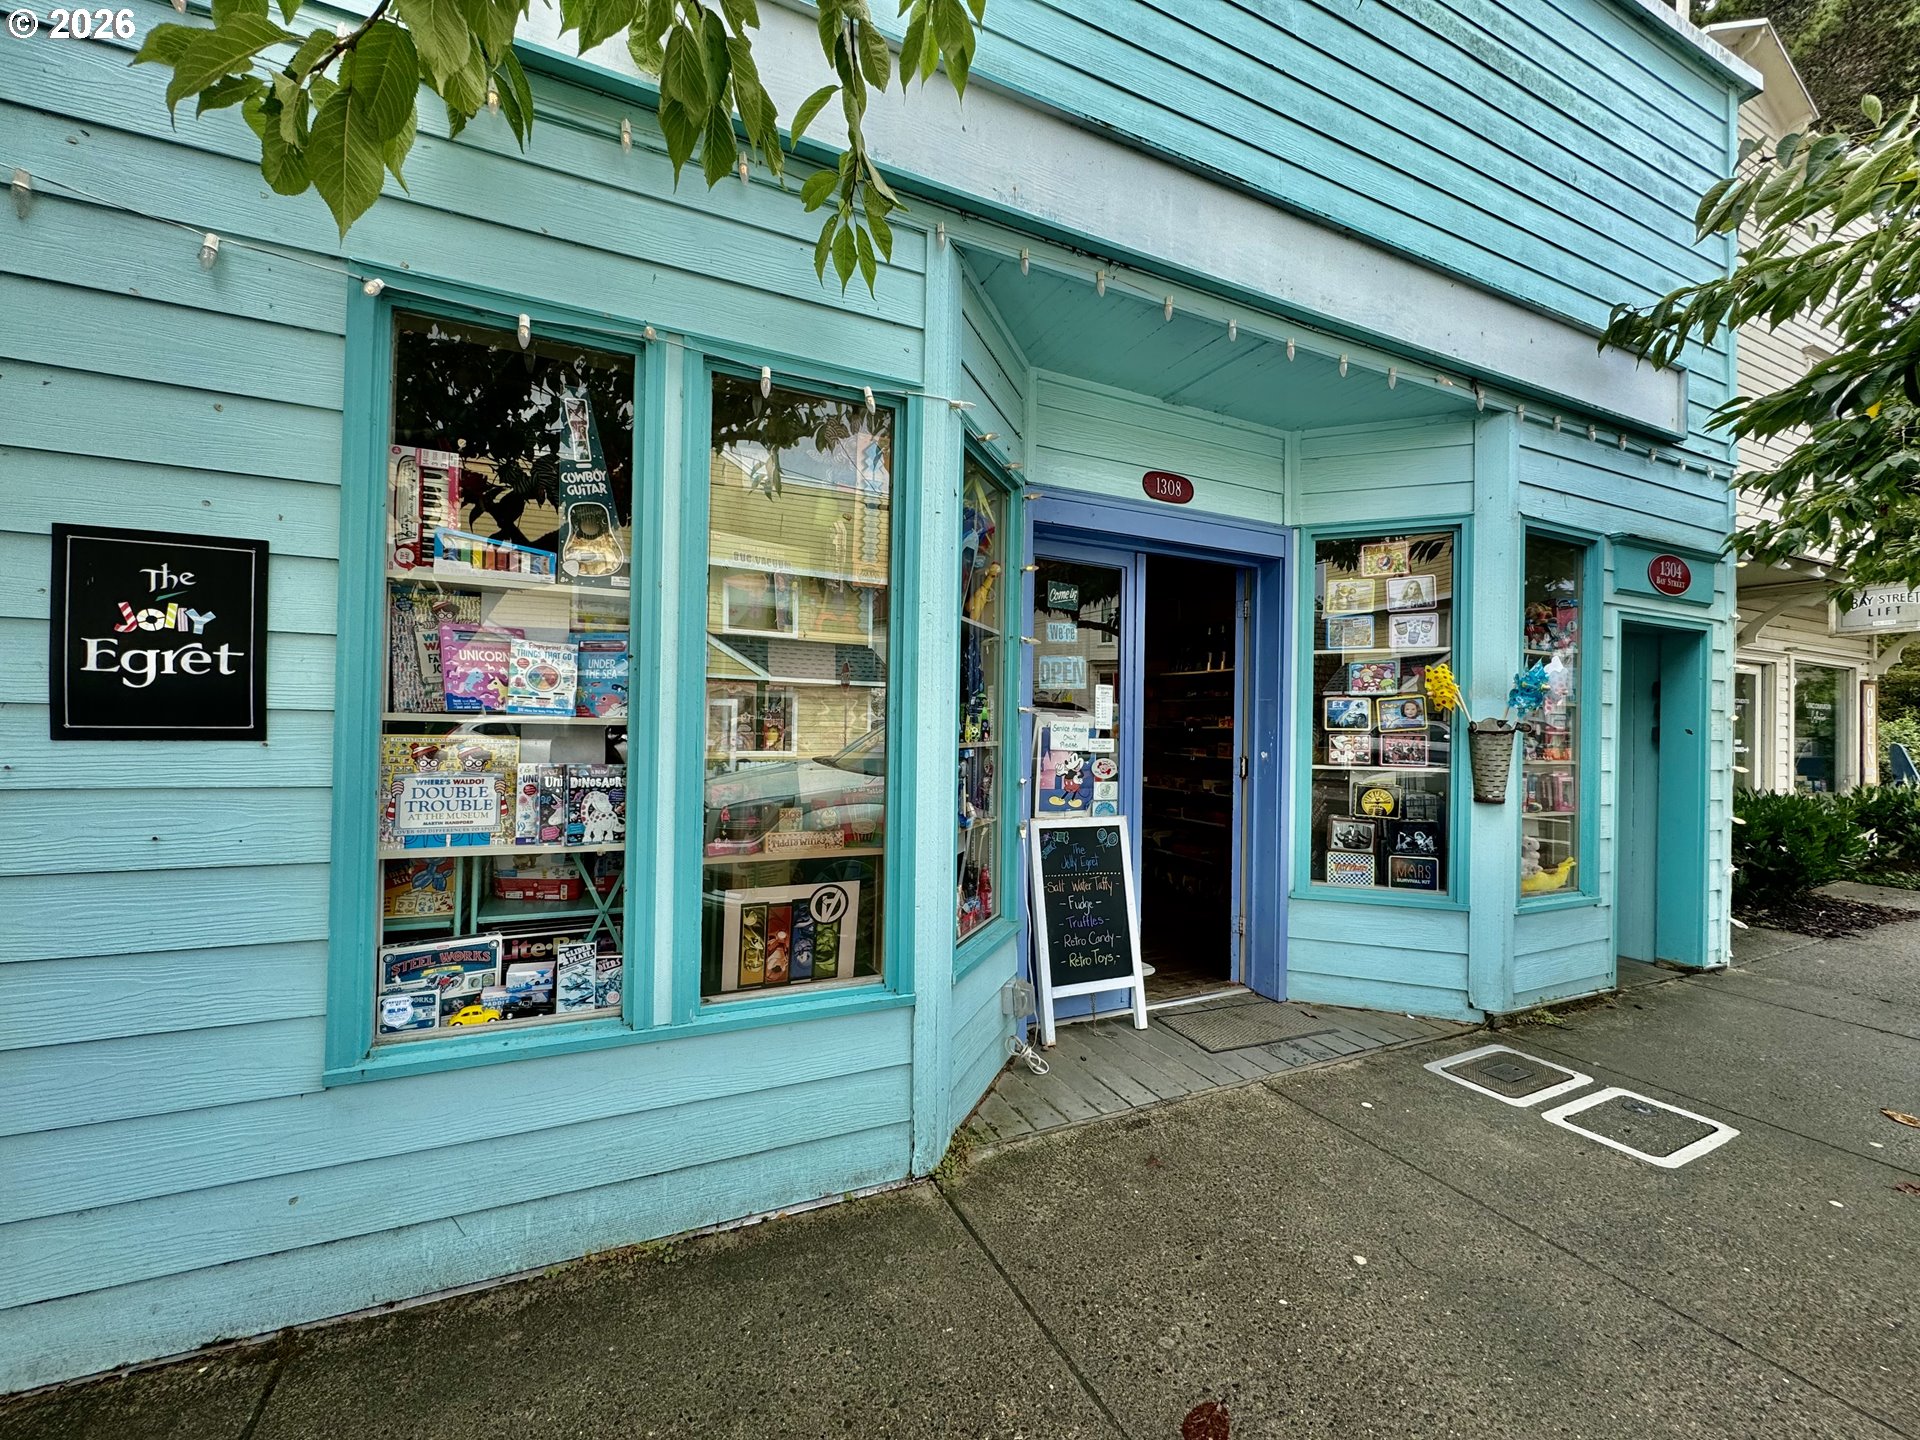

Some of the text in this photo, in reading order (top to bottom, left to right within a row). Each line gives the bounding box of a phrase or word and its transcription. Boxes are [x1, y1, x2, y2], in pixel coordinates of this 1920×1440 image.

[560, 469, 608, 485] COWBOY
[566, 482, 608, 496] GUITAR
[1156, 477, 1182, 497] 1308
[1660, 560, 1682, 578] 1304
[139, 562, 198, 593] The
[1049, 588, 1069, 602] Come
[1852, 591, 1920, 610] BAY STREET
[1868, 605, 1902, 617] LIFT
[1050, 624, 1076, 640] We're
[517, 648, 572, 661] THINGS THAT GO
[80, 637, 245, 688] Egret
[588, 658, 616, 669] UNDER
[585, 669, 618, 679] THE SEA
[1041, 660, 1086, 683] OPEN
[1051, 723, 1070, 733] Service
[1866, 688, 1874, 765] OPEN
[522, 774, 539, 783] UND
[412, 786, 489, 800] DOUBLE
[404, 799, 494, 813] TROUBLE
[408, 811, 489, 821] AT THE MUSEUM
[1070, 842, 1087, 855] The
[1080, 852, 1100, 872] Egret
[1396, 863, 1432, 879] MARS
[1047, 876, 1113, 897] Salt Water Taffy
[1396, 877, 1421, 885] SURVIVAL
[1067, 895, 1094, 915] Fudge
[1065, 915, 1105, 929] Truffles
[1063, 930, 1115, 948] Retro Candy
[559, 951, 570, 966] 4
[565, 944, 592, 958] GLIDER
[568, 949, 596, 964] PLANES
[390, 954, 436, 976] STEEL
[439, 950, 491, 964] WORKS
[1068, 952, 1092, 967] Retro
[413, 996, 434, 1005] ORKS
